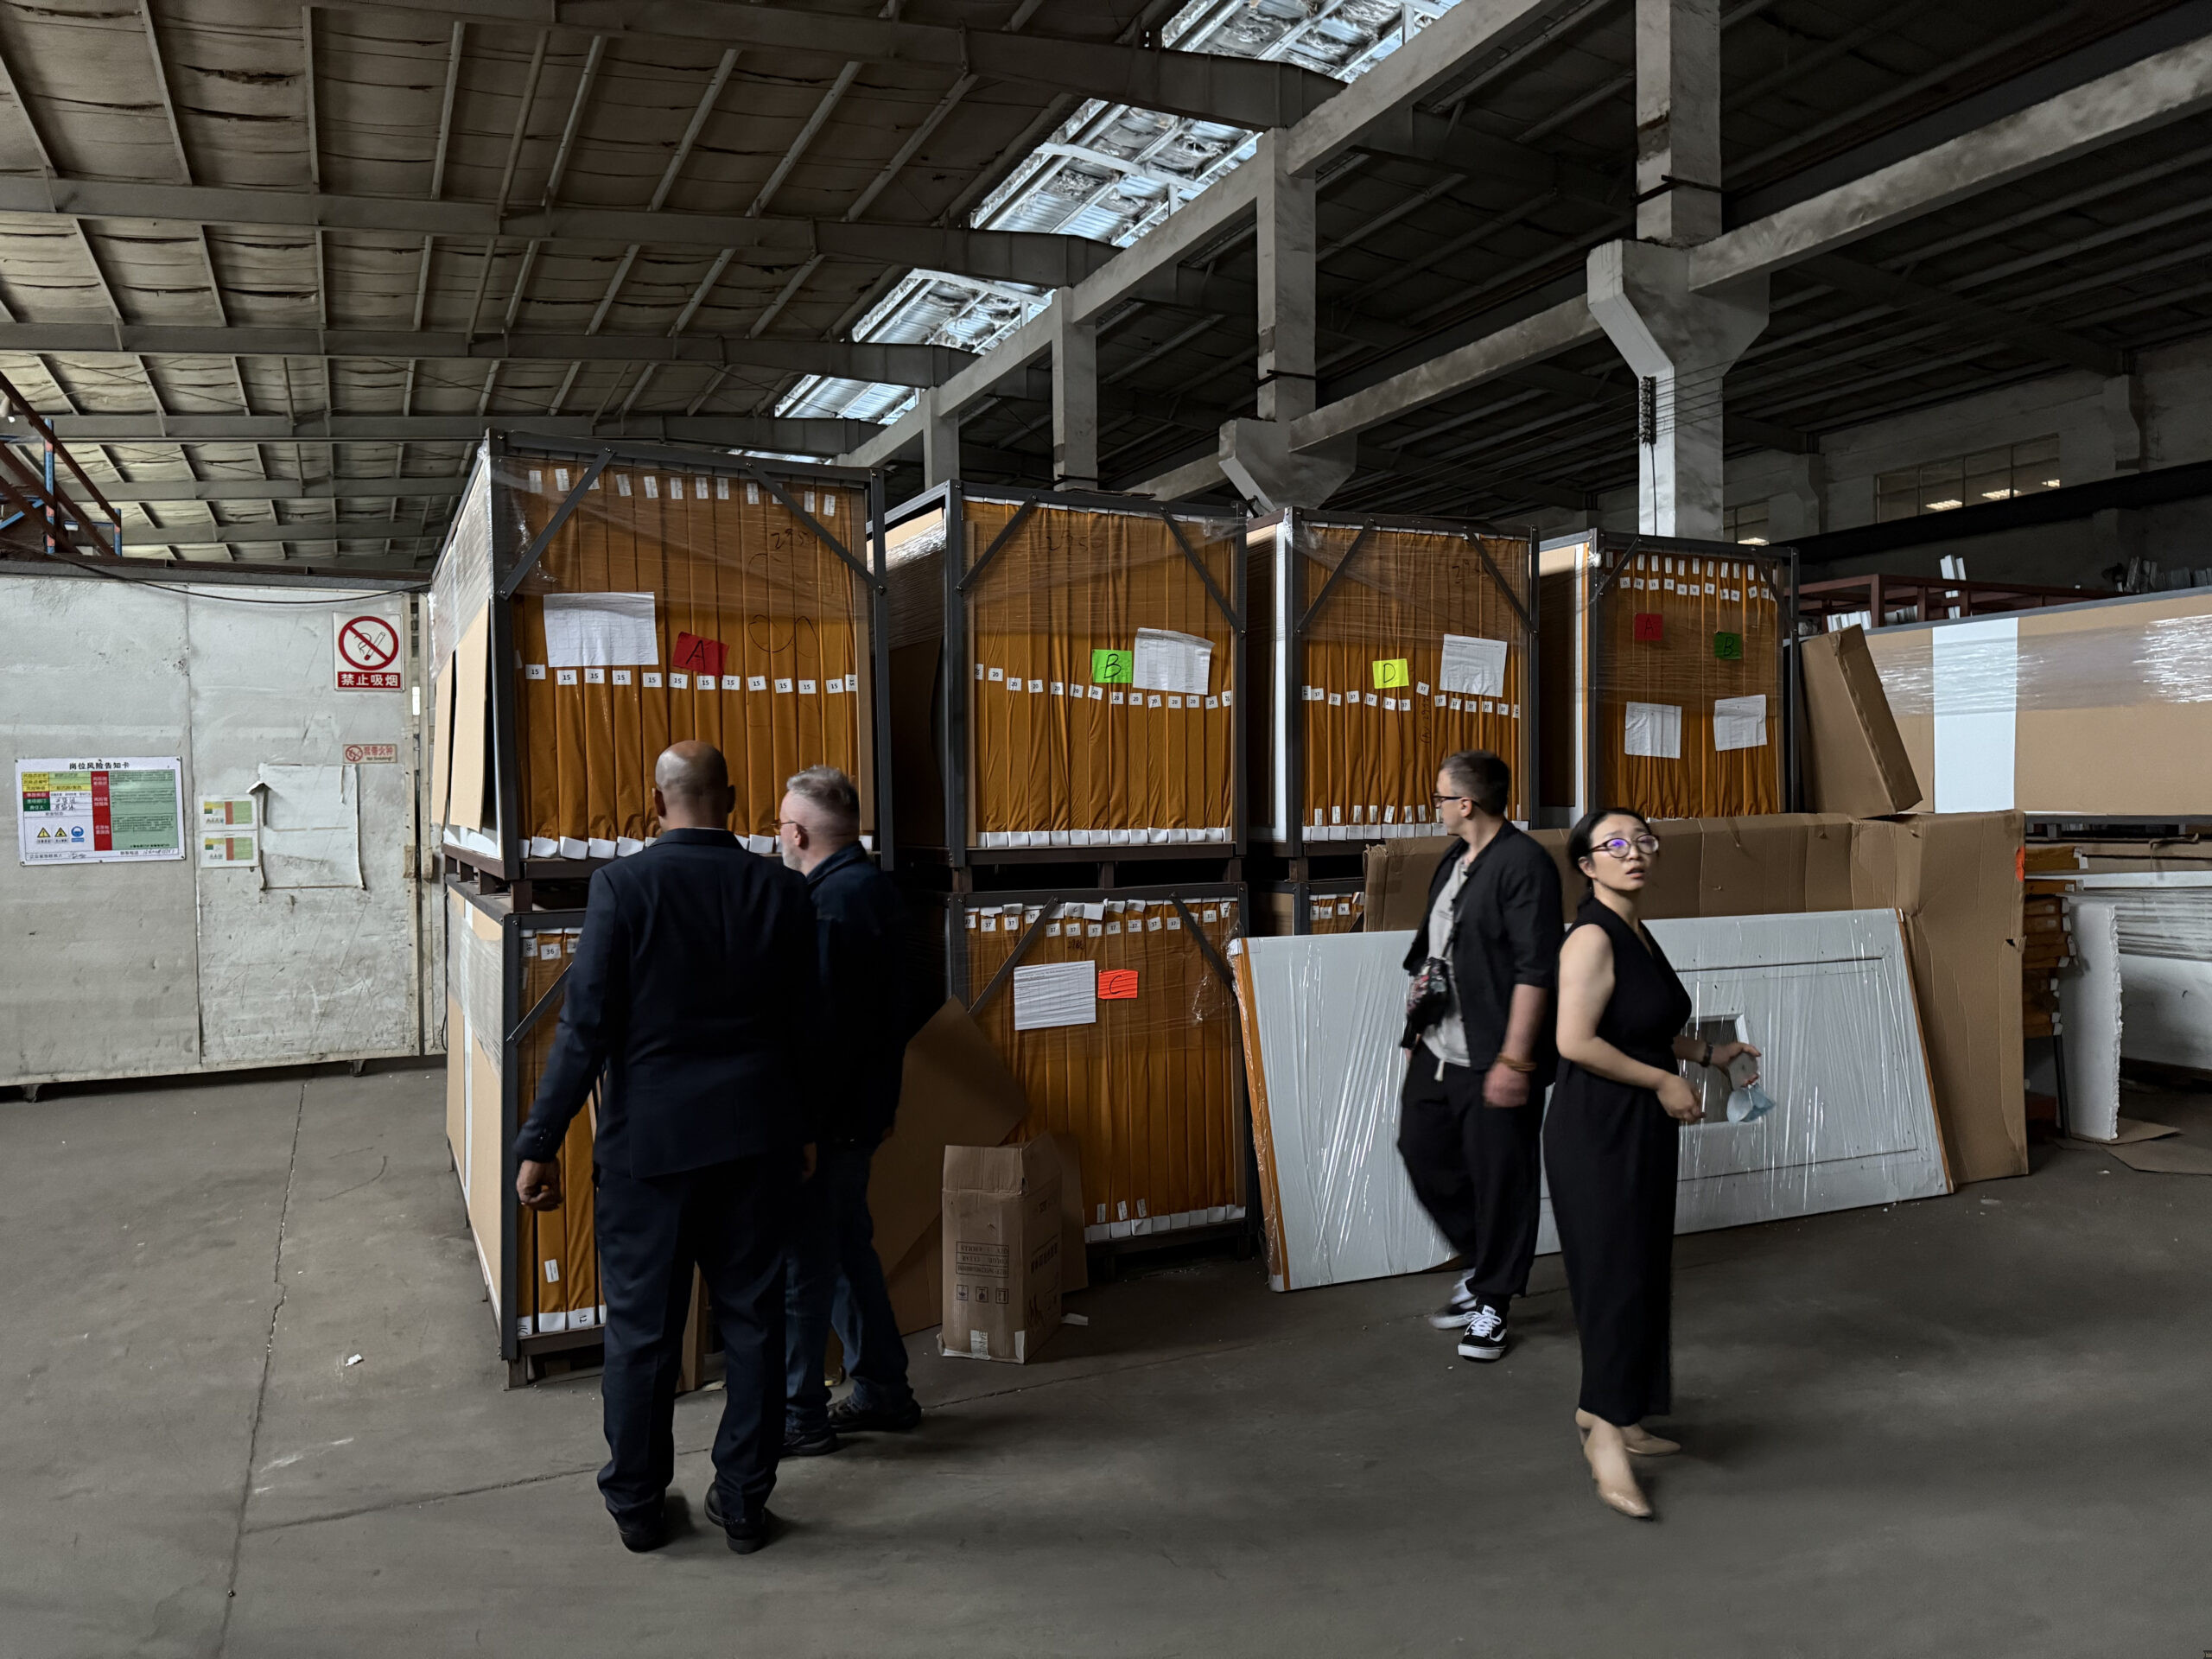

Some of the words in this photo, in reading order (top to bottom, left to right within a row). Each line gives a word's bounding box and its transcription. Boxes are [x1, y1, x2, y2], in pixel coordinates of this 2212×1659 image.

[1644, 617, 1654, 636] A
[685, 639, 705, 671] A
[1723, 636, 1734, 656] B
[1103, 653, 1122, 678] B
[1383, 663, 1395, 683] D
[340, 673, 398, 687] 禁止吸烟
[1109, 975, 1122, 995] C
